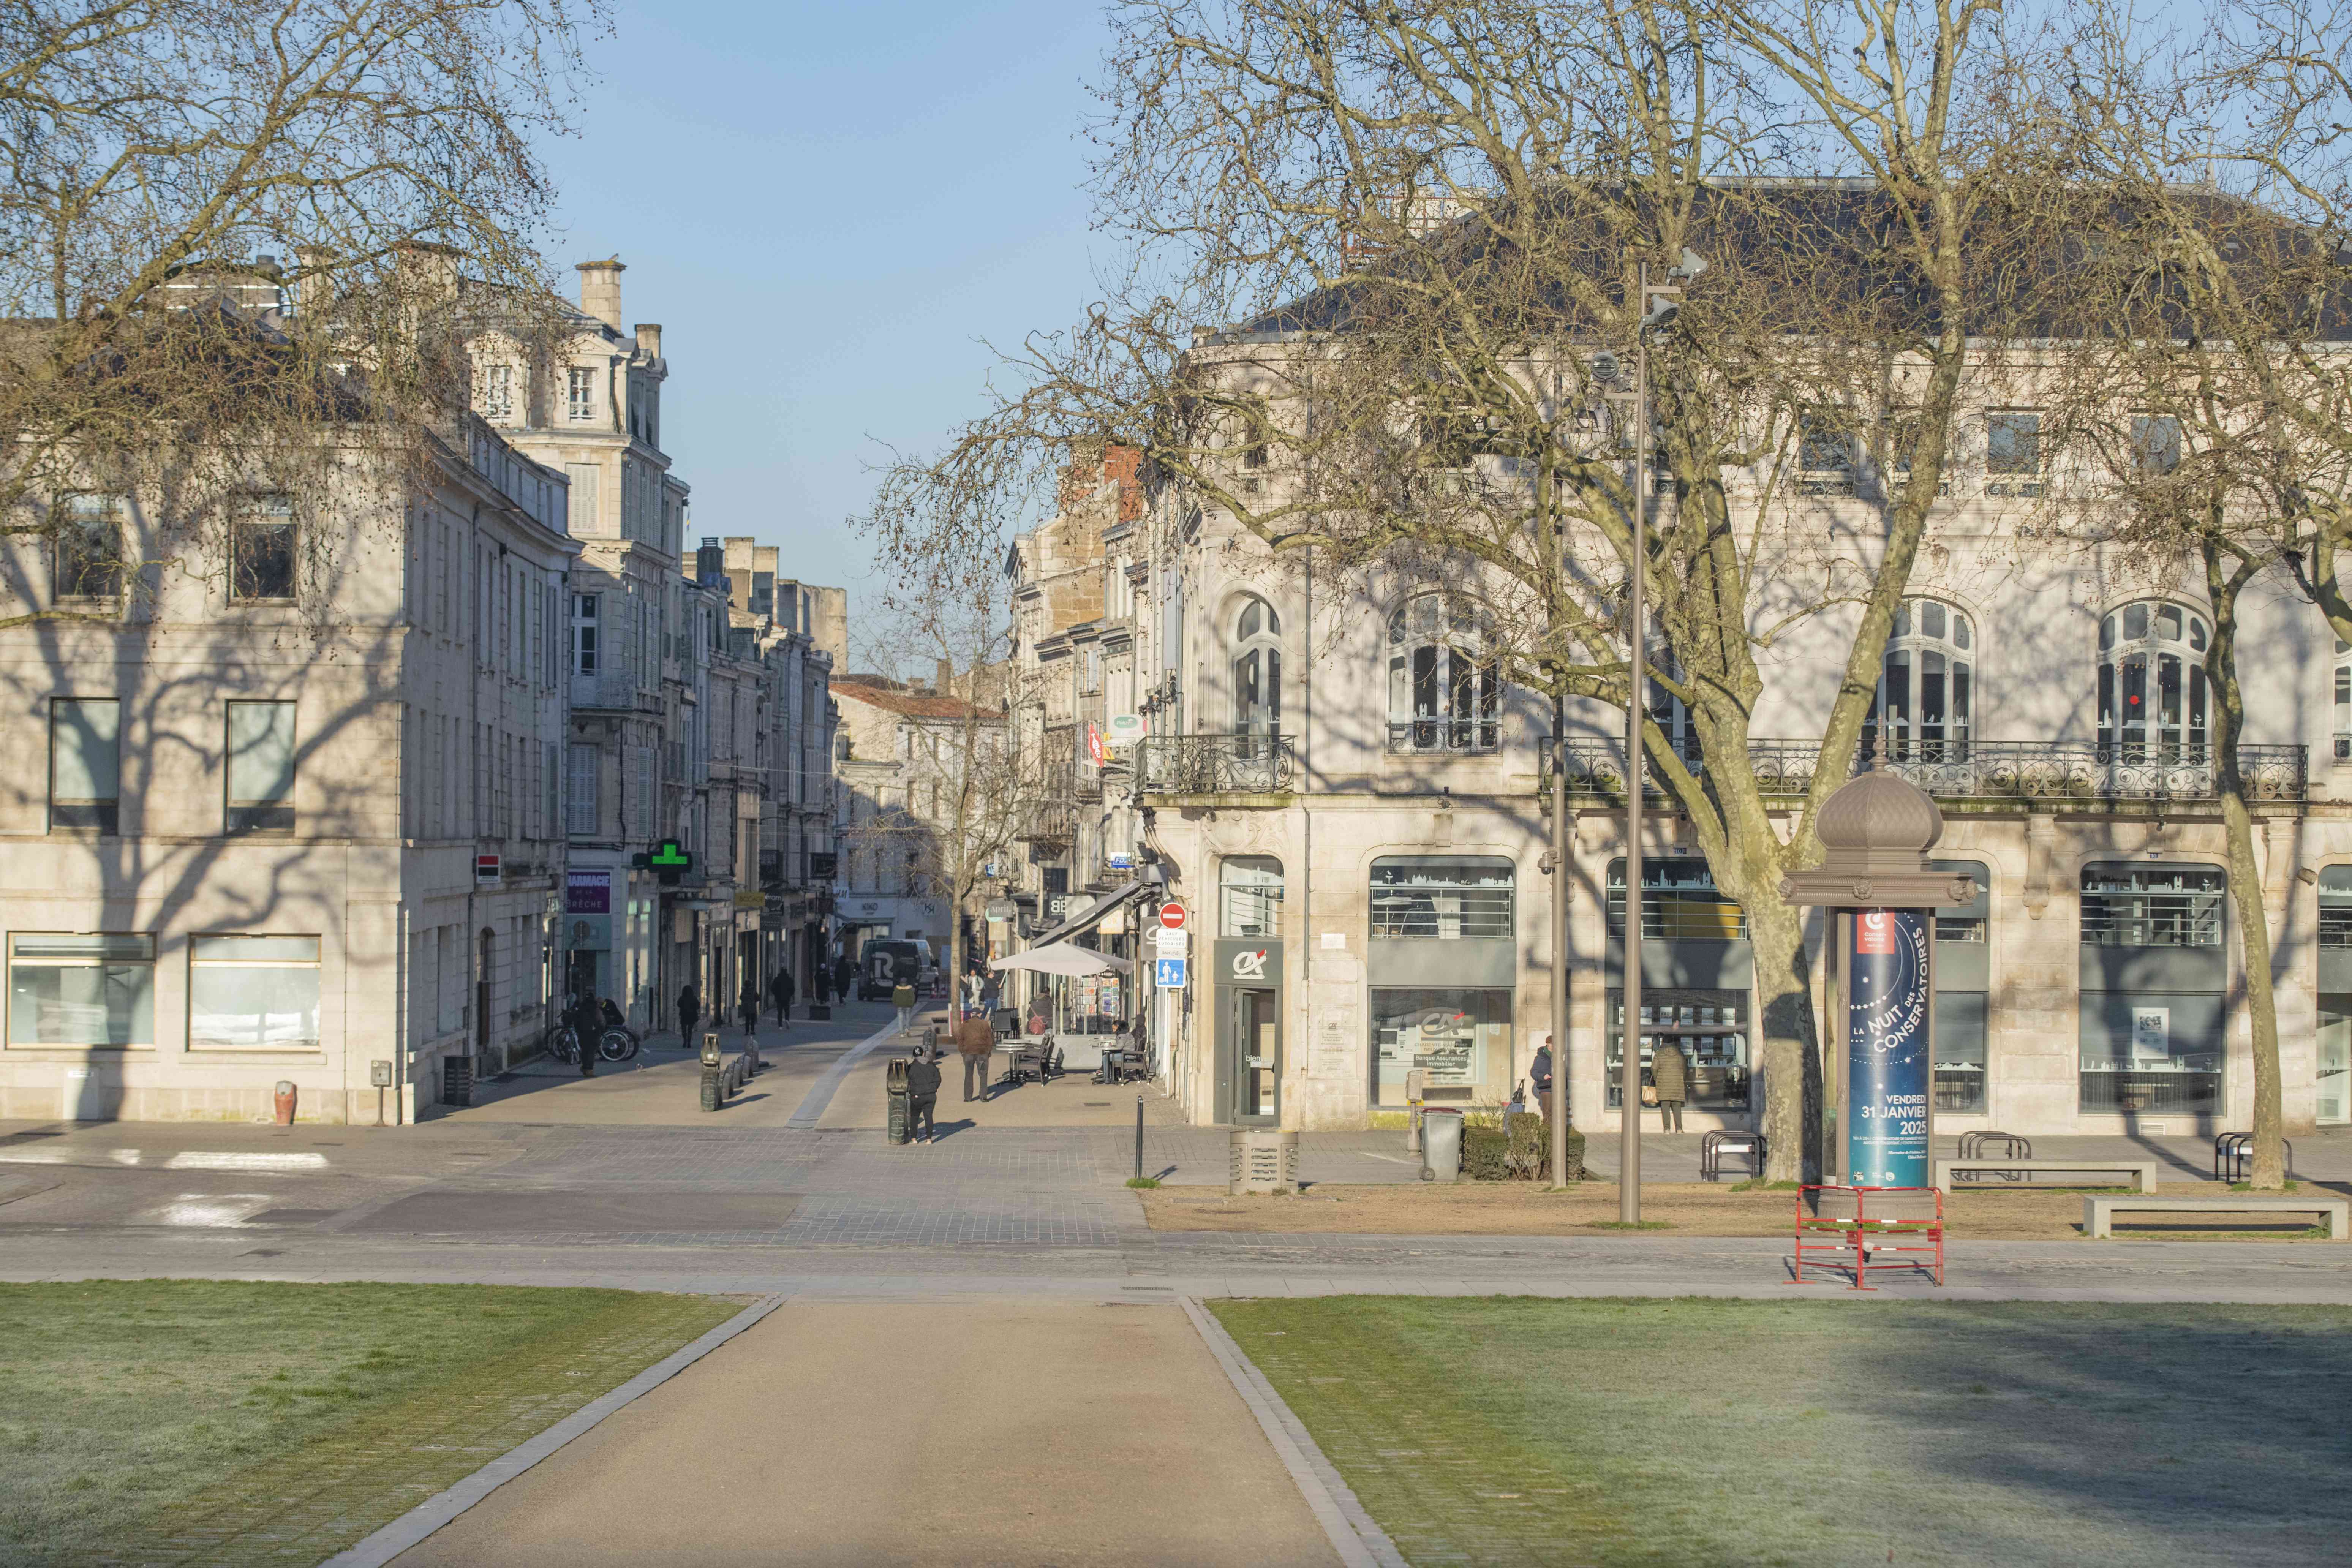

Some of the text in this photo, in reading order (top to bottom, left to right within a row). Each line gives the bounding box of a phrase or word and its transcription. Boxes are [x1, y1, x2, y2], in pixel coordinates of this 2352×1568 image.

[1091, 733, 1101, 759] TABAC
[862, 903, 878, 911] KIKO
[1873, 927, 1927, 1053] CONSERVATOIRES
[1867, 1005, 1904, 1034] NUIT
[1904, 991, 1916, 1007] DES
[1886, 1095, 1927, 1104] VENDREDI
[1862, 1106, 1927, 1118] 31 JANVIER
[1900, 1121, 1927, 1135] 2025
